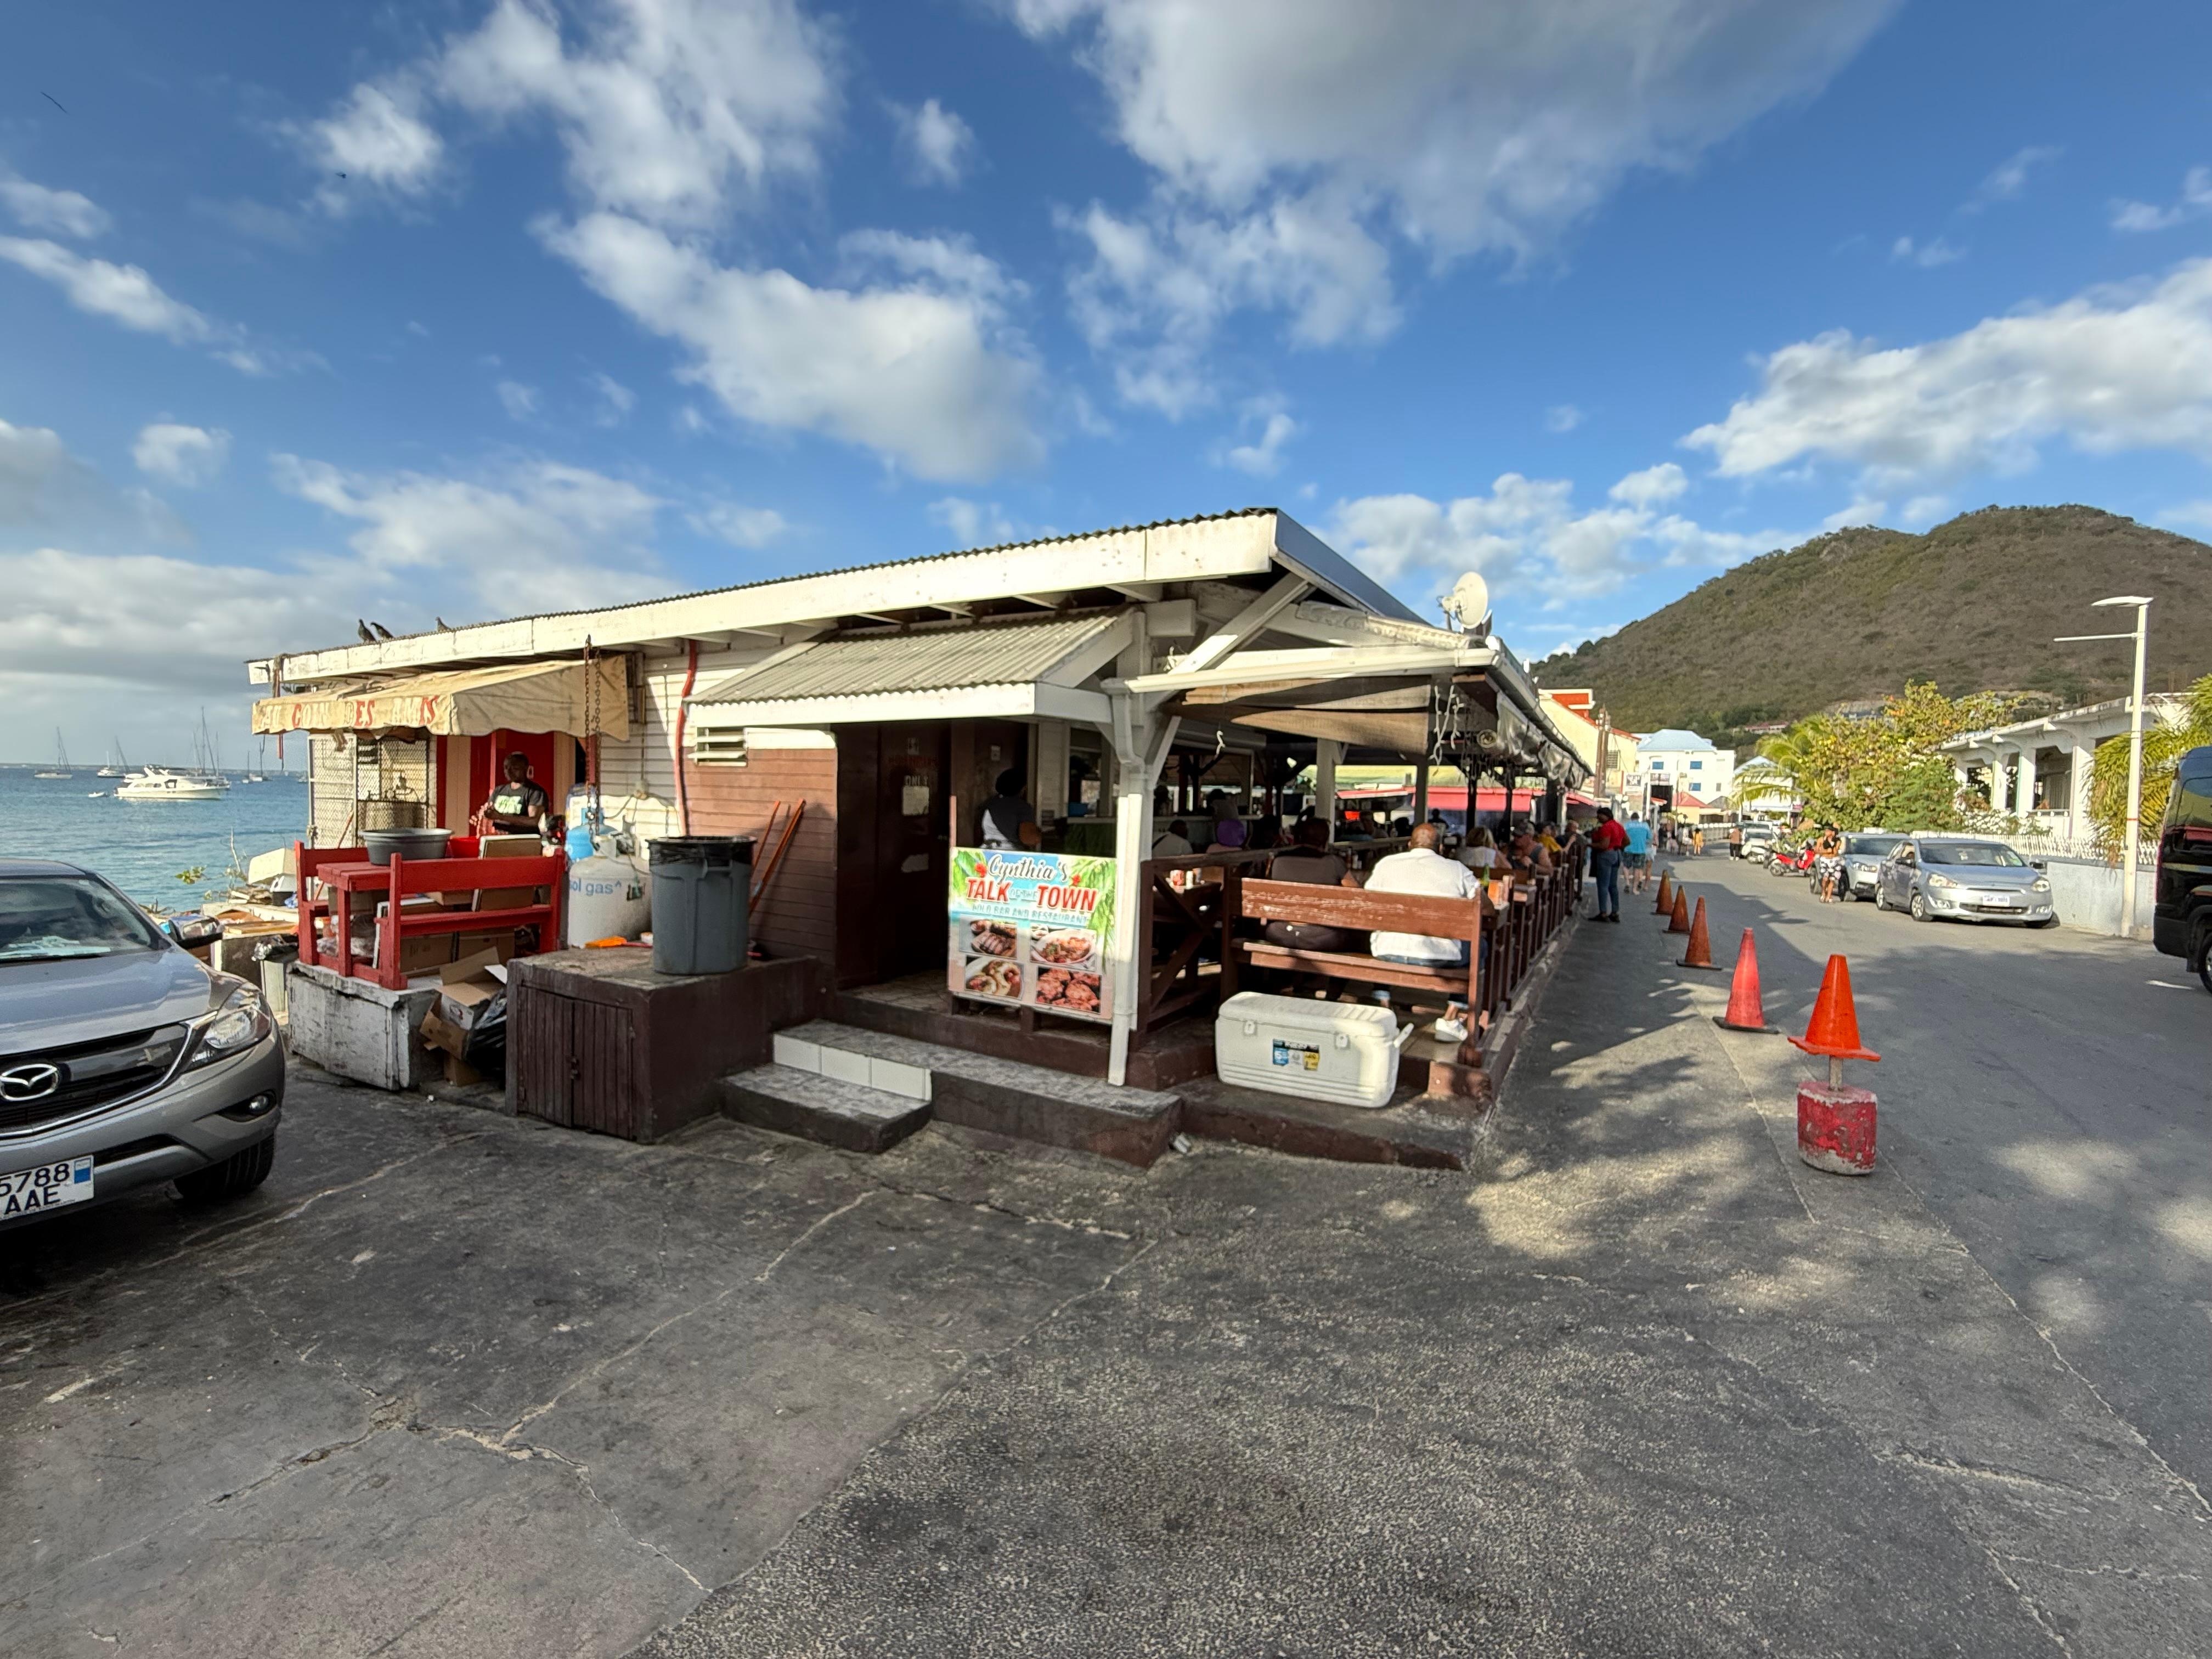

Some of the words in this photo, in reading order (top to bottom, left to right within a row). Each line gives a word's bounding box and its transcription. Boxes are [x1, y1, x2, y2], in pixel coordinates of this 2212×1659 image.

[261, 706, 281, 728] AU
[291, 702, 329, 729] COIN
[345, 699, 375, 727] DES
[392, 695, 437, 726] AMIS
[967, 878, 1012, 902] TALK
[1038, 885, 1097, 911] TOWN
[4, 1183, 61, 1215] AAE
